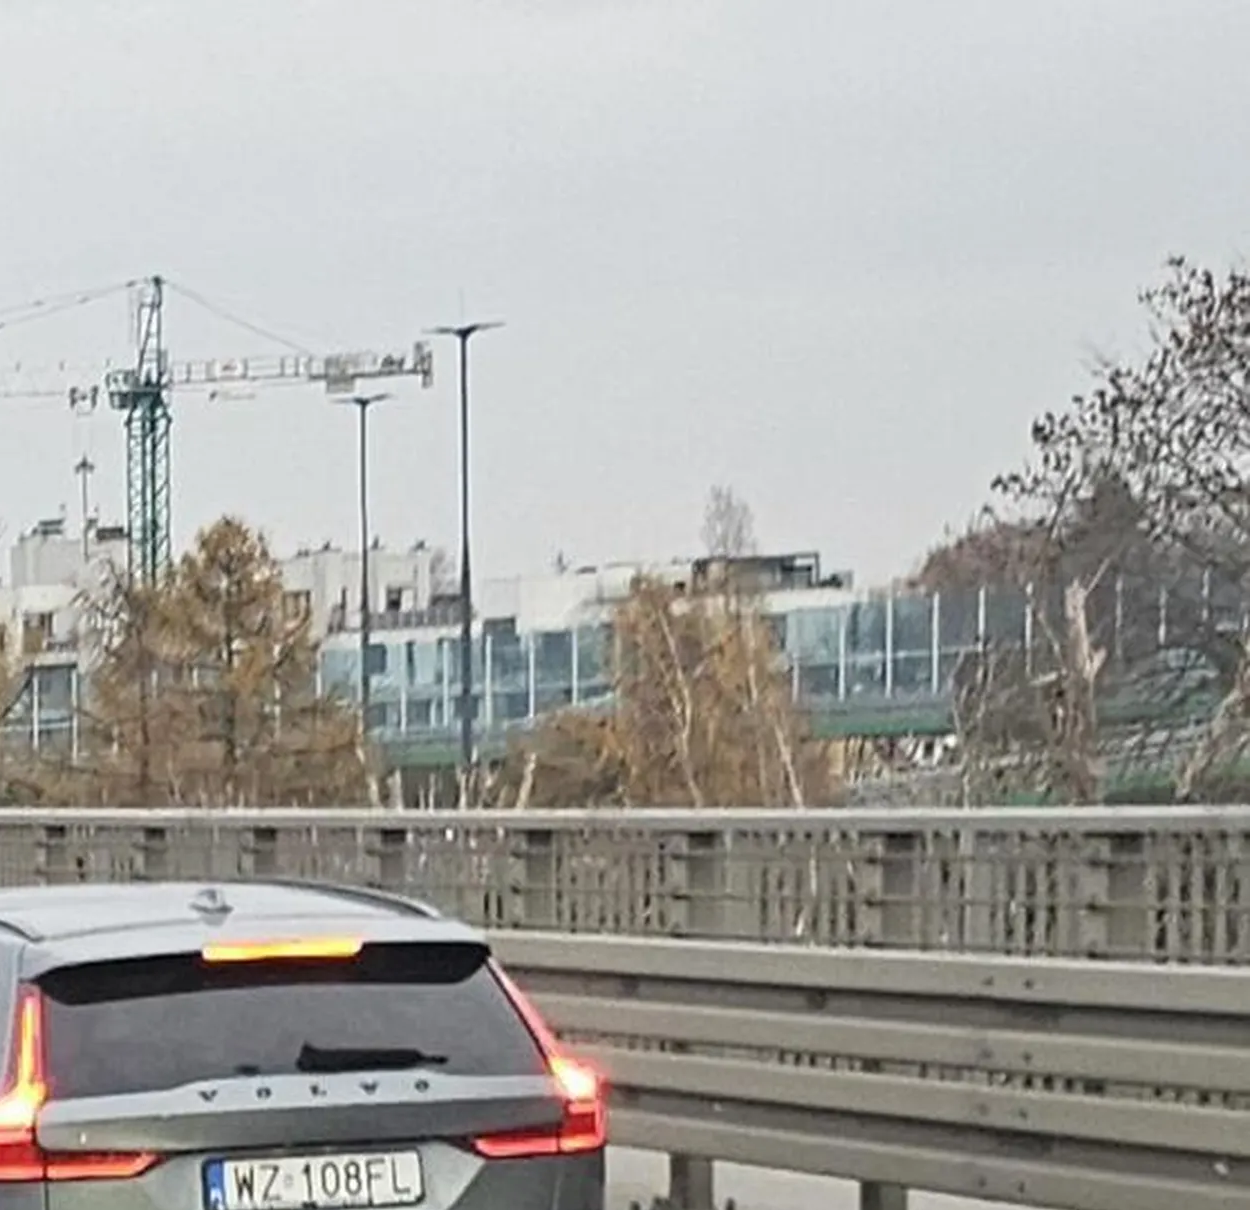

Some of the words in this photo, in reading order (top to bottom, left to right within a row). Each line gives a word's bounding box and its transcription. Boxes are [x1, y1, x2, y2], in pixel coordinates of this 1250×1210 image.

[197, 1078, 430, 1102] VOLVO
[233, 1164, 283, 1201] WZ
[301, 1157, 411, 1201] 108FL
